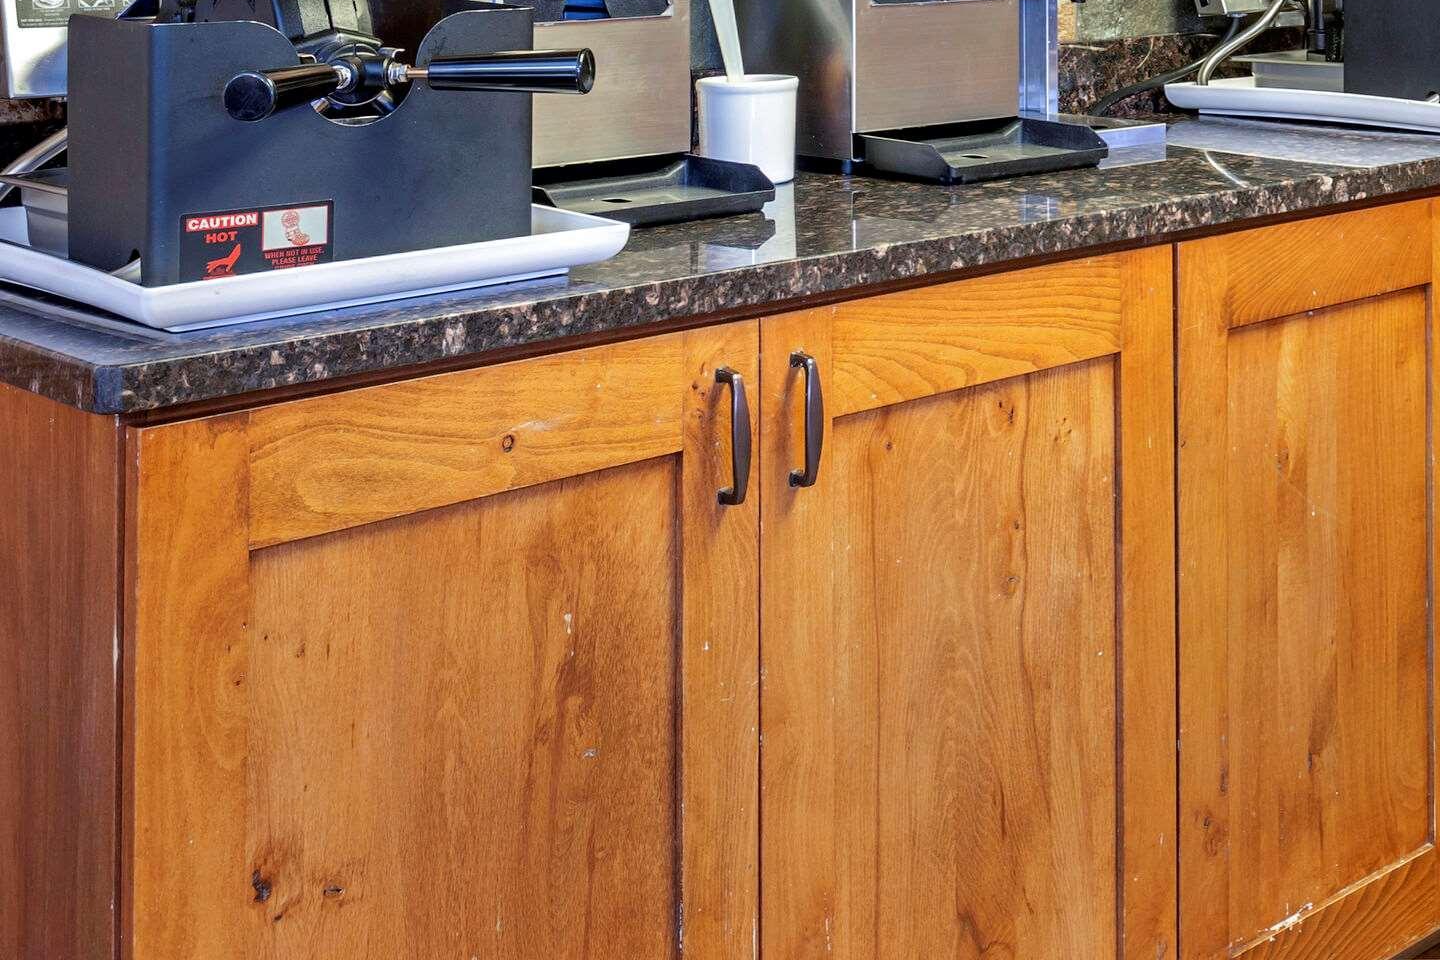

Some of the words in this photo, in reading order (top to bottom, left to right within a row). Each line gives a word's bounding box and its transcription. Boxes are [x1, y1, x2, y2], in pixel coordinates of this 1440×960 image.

[187, 213, 257, 231] CAUTION
[205, 230, 238, 243] HOT
[285, 249, 299, 257] NOT
[271, 256, 297, 265] PLEASE
[298, 254, 318, 262] LEAVE
